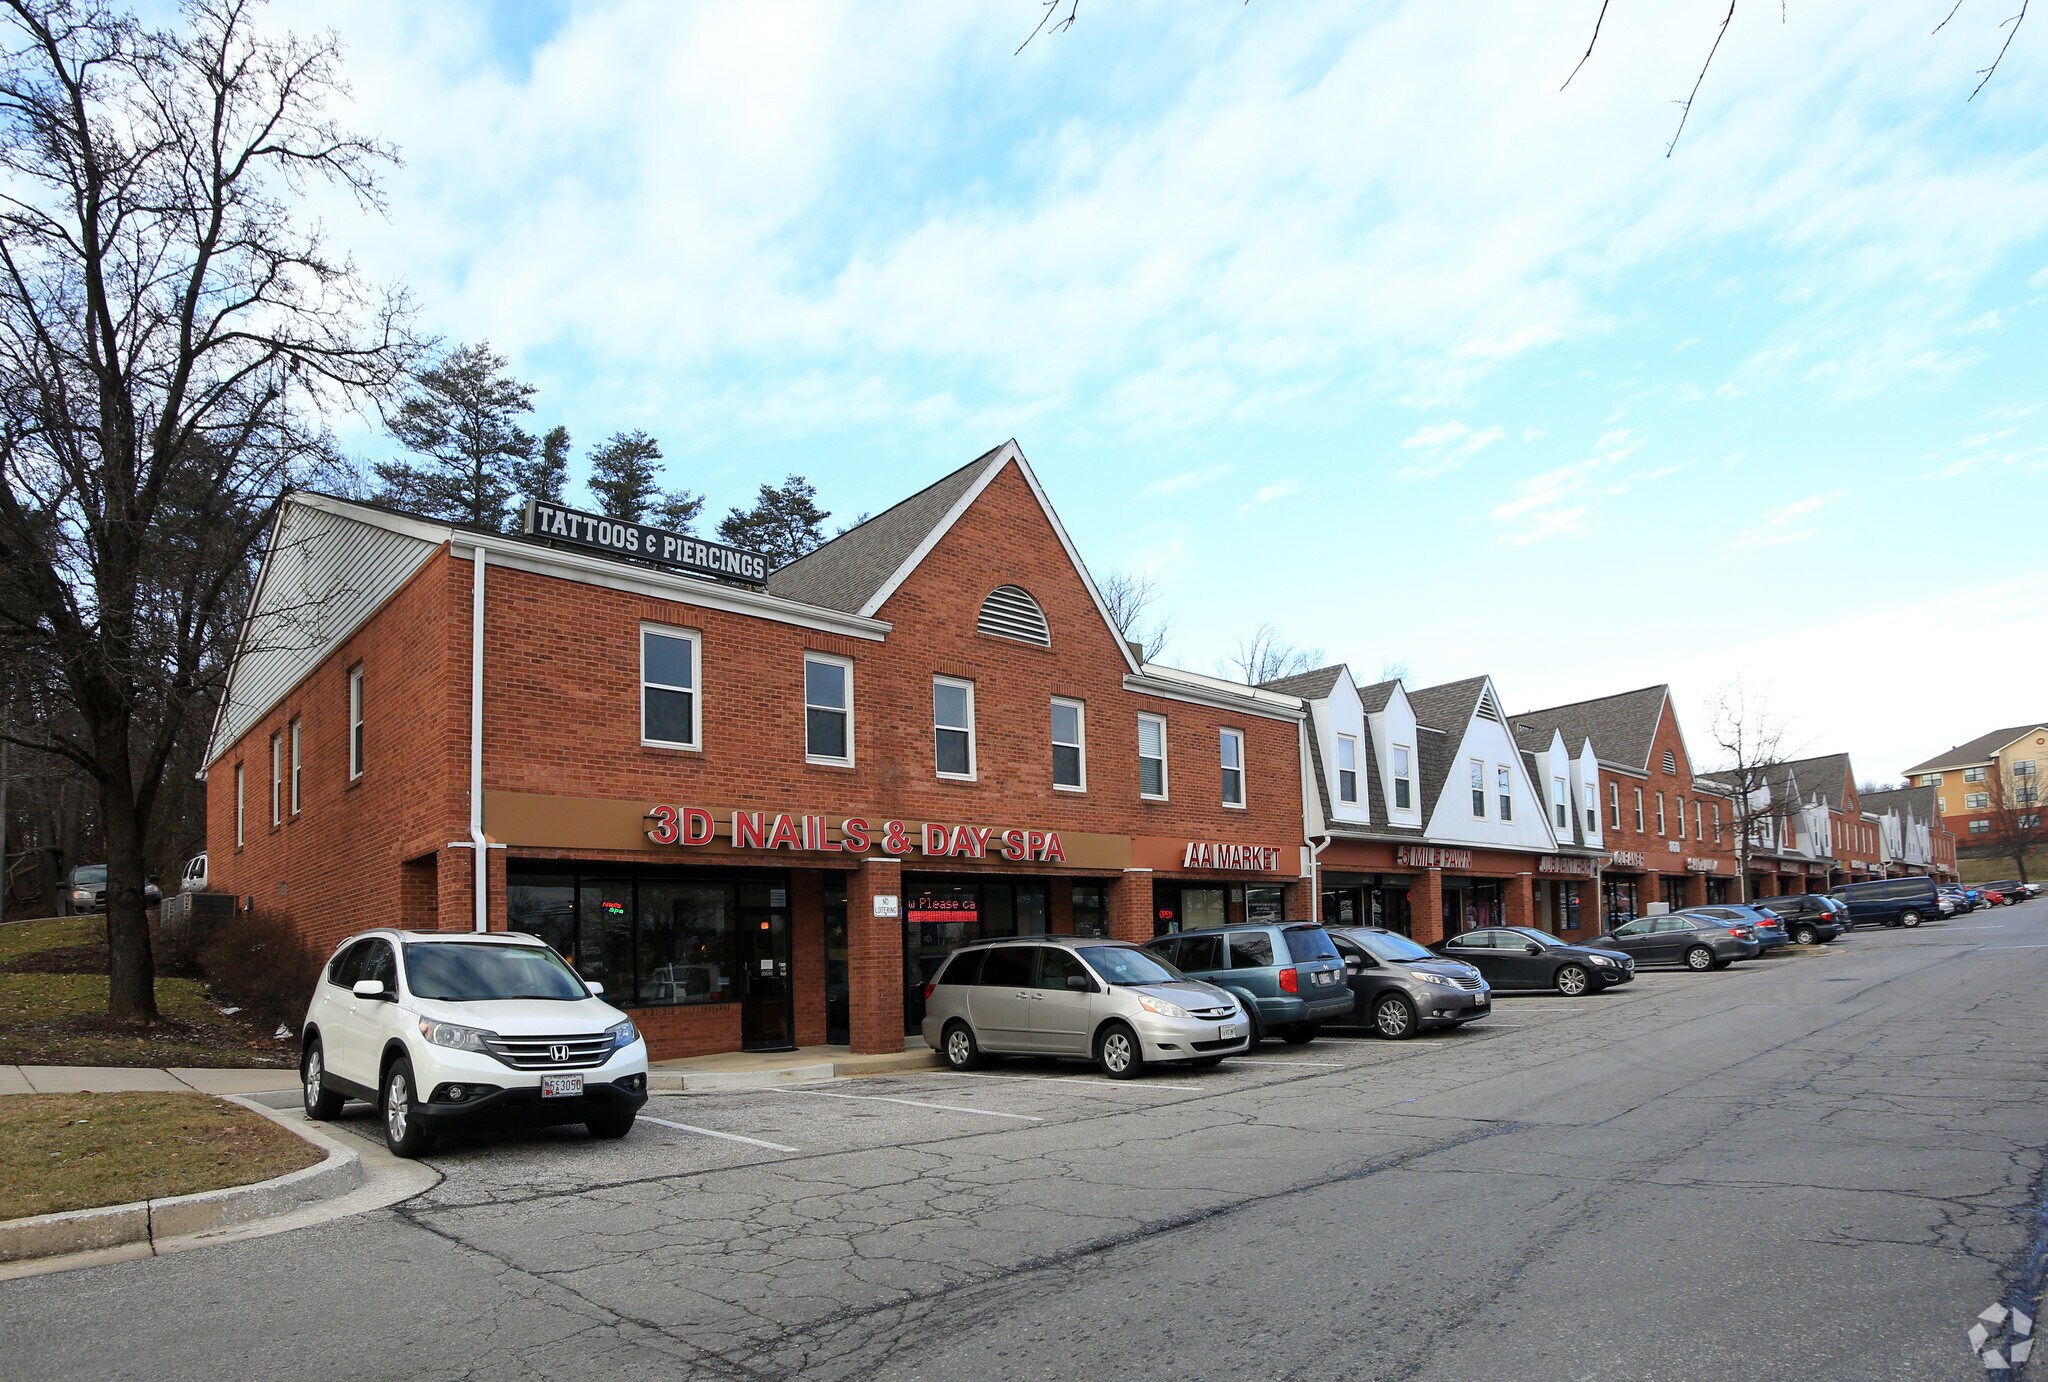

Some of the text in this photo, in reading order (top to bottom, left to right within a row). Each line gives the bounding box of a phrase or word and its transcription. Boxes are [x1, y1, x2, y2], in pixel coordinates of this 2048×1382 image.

[538, 506, 765, 579] TATTOOS & PIERCINGS
[648, 805, 1067, 863] 3D NAILS & DAY SPA
[1184, 842, 1281, 871] AA MARKET
[1410, 847, 1440, 866] MILE
[1440, 848, 1472, 868] PAWN
[875, 906, 897, 914] LOITERING
[919, 897, 959, 909] Please
[962, 901, 976, 909] ca
[1159, 910, 1173, 919] OPEN
